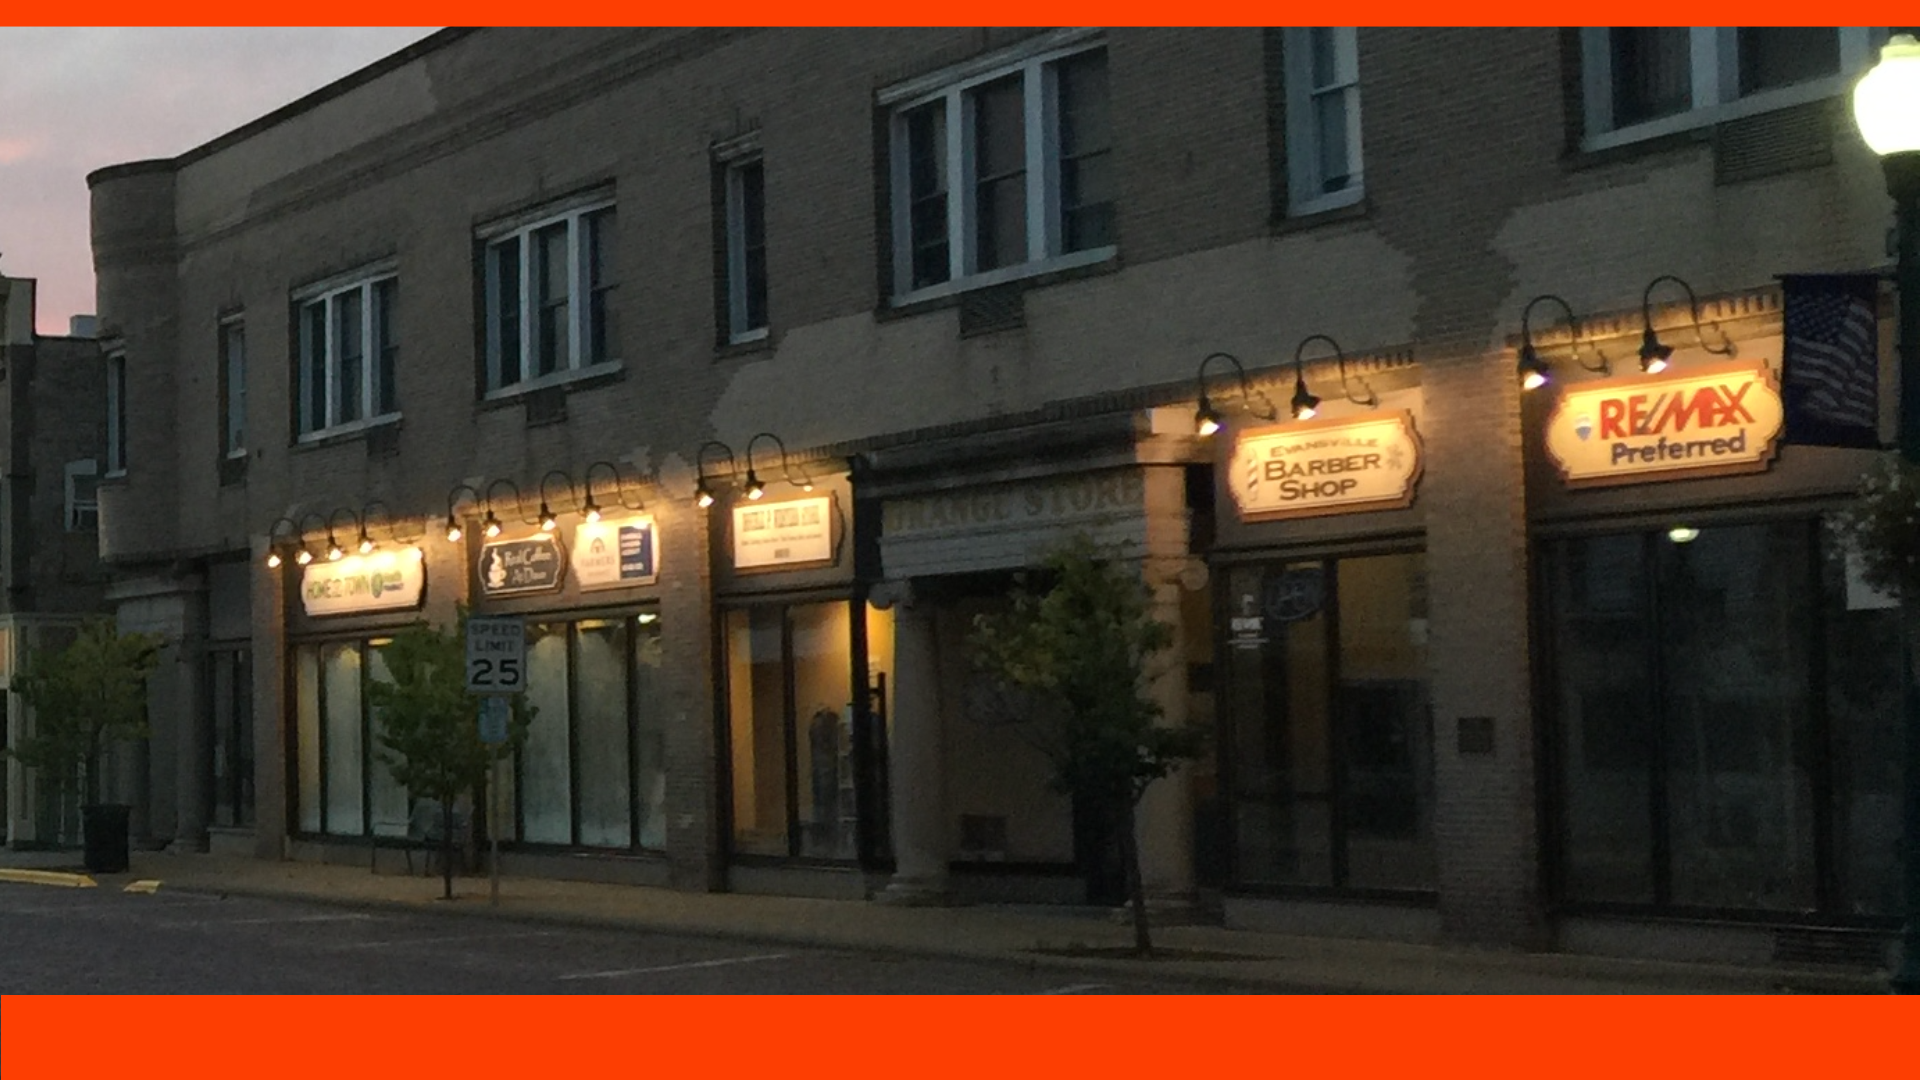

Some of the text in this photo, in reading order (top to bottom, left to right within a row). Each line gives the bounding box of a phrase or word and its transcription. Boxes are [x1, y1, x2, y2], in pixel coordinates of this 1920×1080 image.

[1600, 381, 1756, 440] RE/MAX
[1611, 428, 1746, 466] Preferred
[1264, 453, 1381, 481] BARBER
[1279, 478, 1358, 501] SHOP
[470, 623, 520, 636] SPEED
[475, 641, 513, 653] LIMIT
[471, 658, 519, 685] 25
